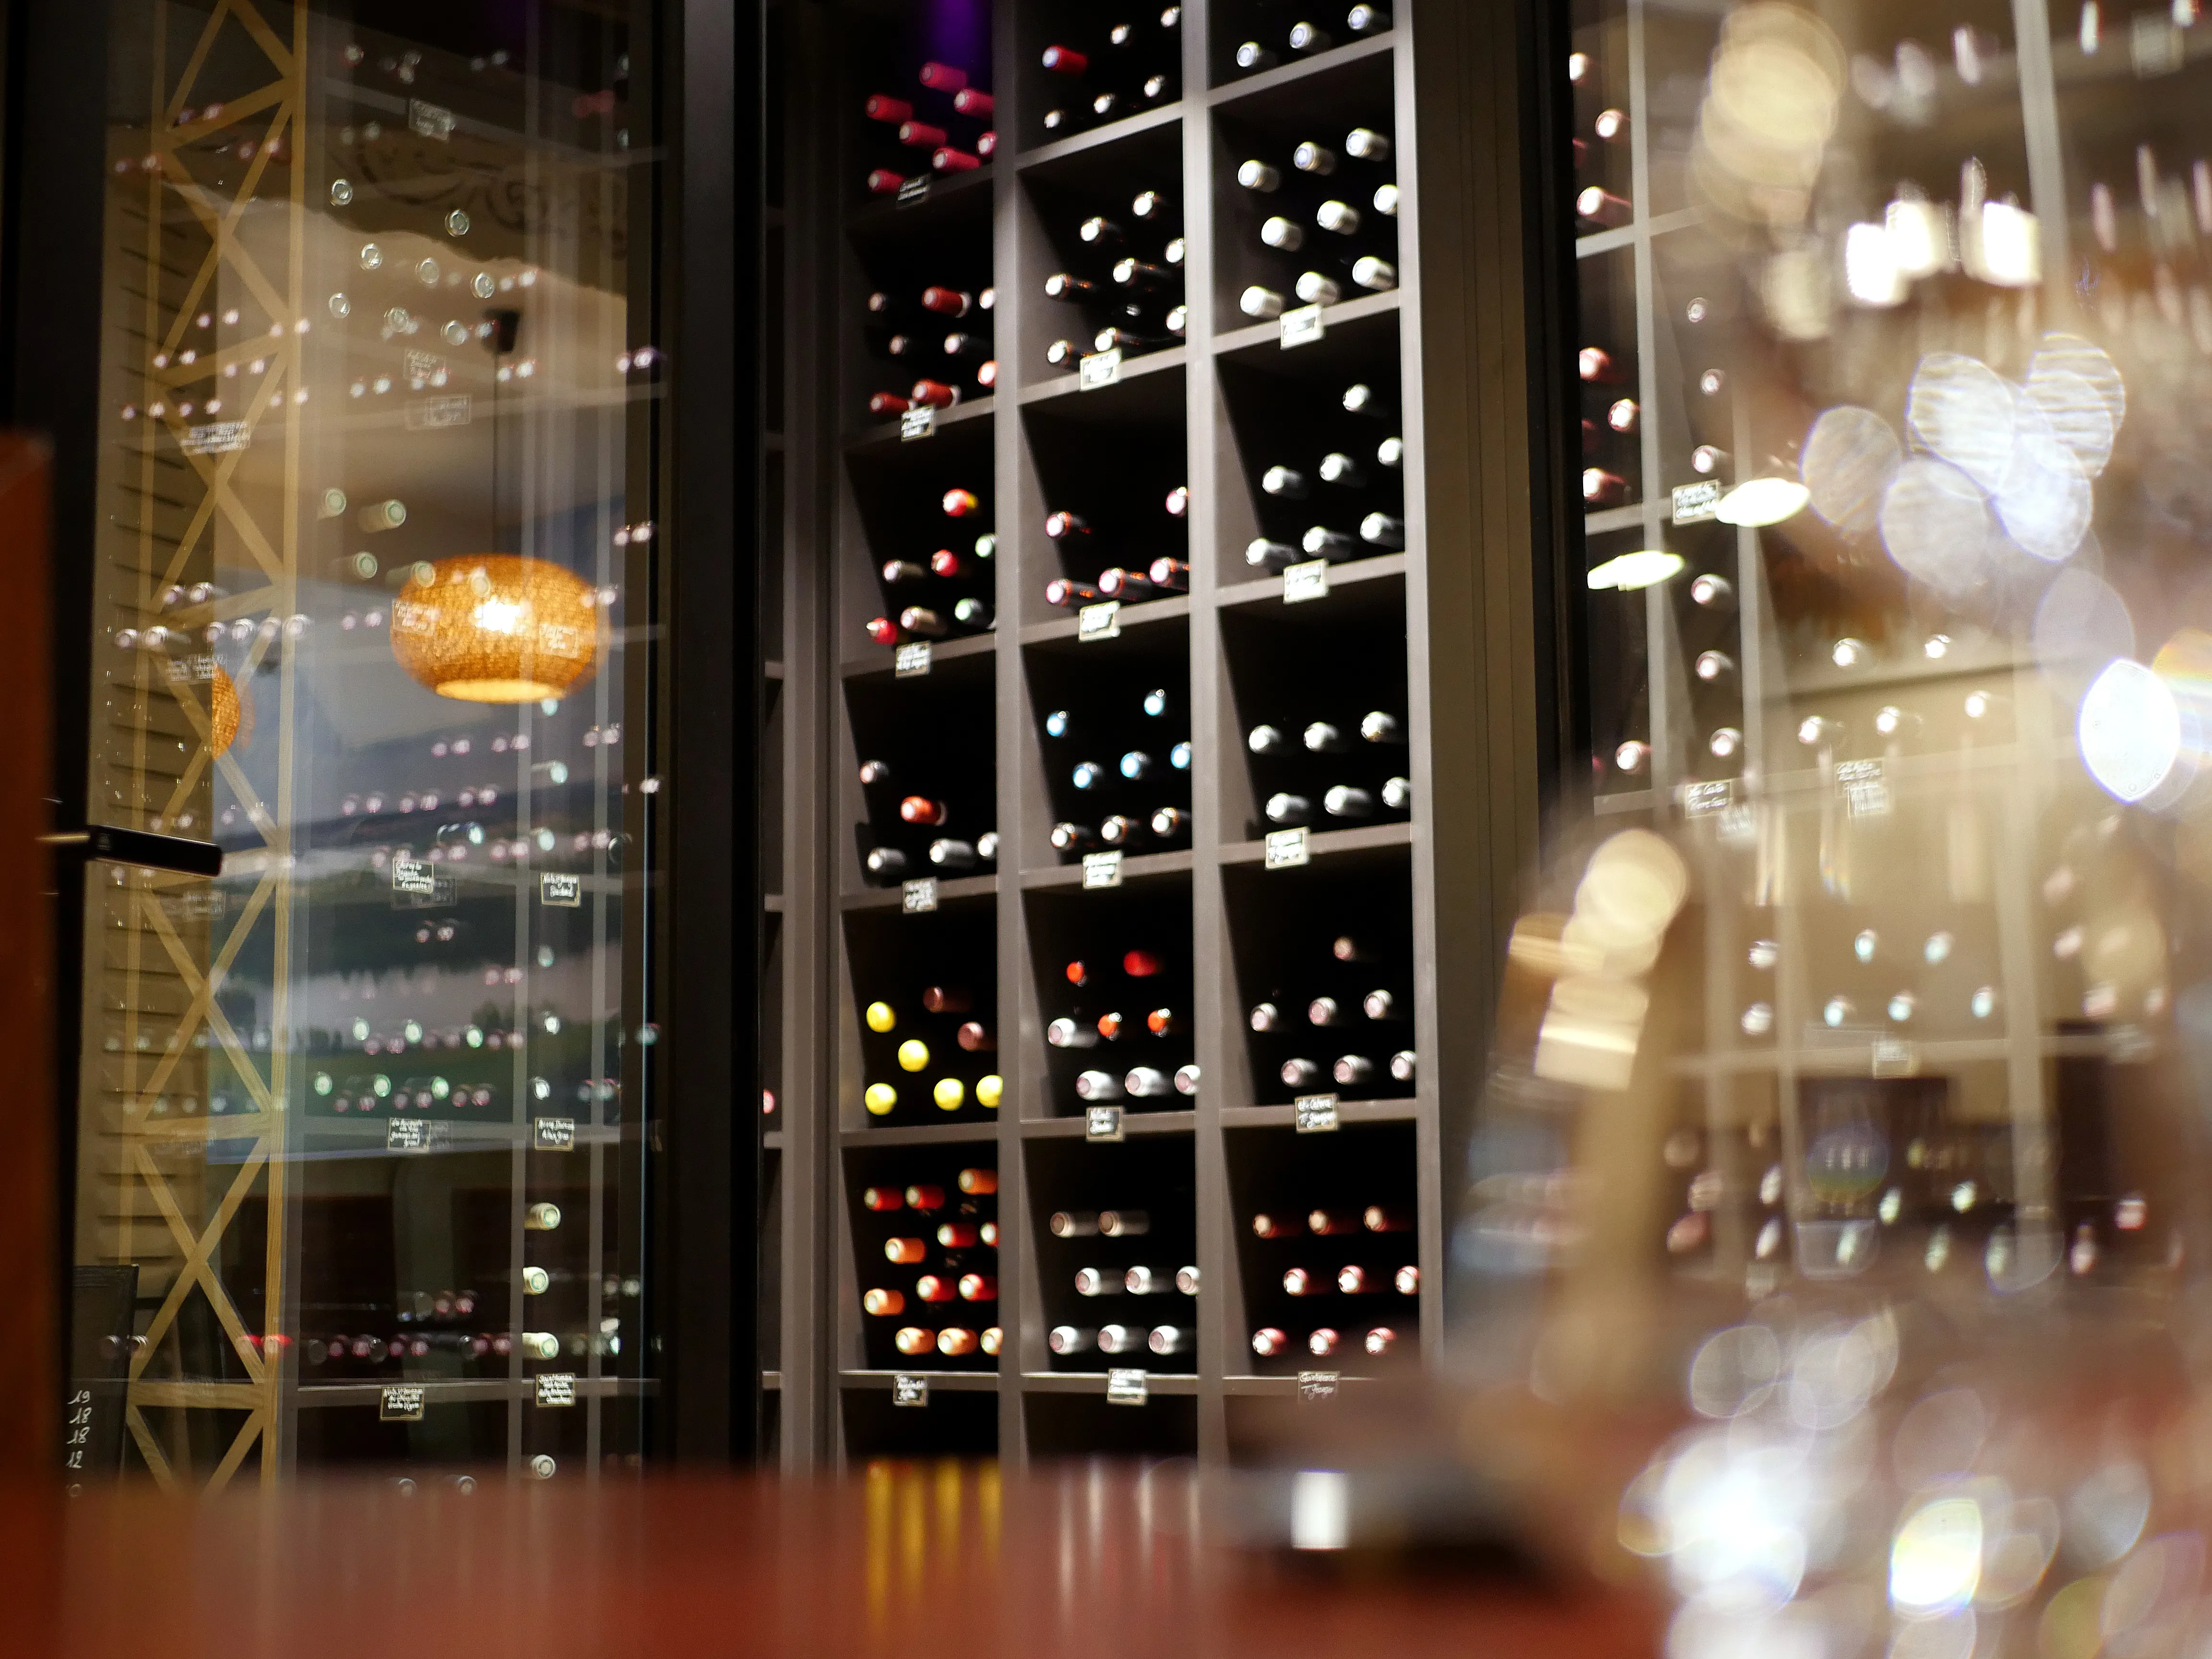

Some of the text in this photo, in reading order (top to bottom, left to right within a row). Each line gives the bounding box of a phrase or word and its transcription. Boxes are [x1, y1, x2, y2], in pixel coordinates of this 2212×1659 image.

[68, 1390, 90, 1405] 19
[69, 1407, 92, 1424] 18
[67, 1426, 90, 1444] 18
[66, 1450, 83, 1469] 12
